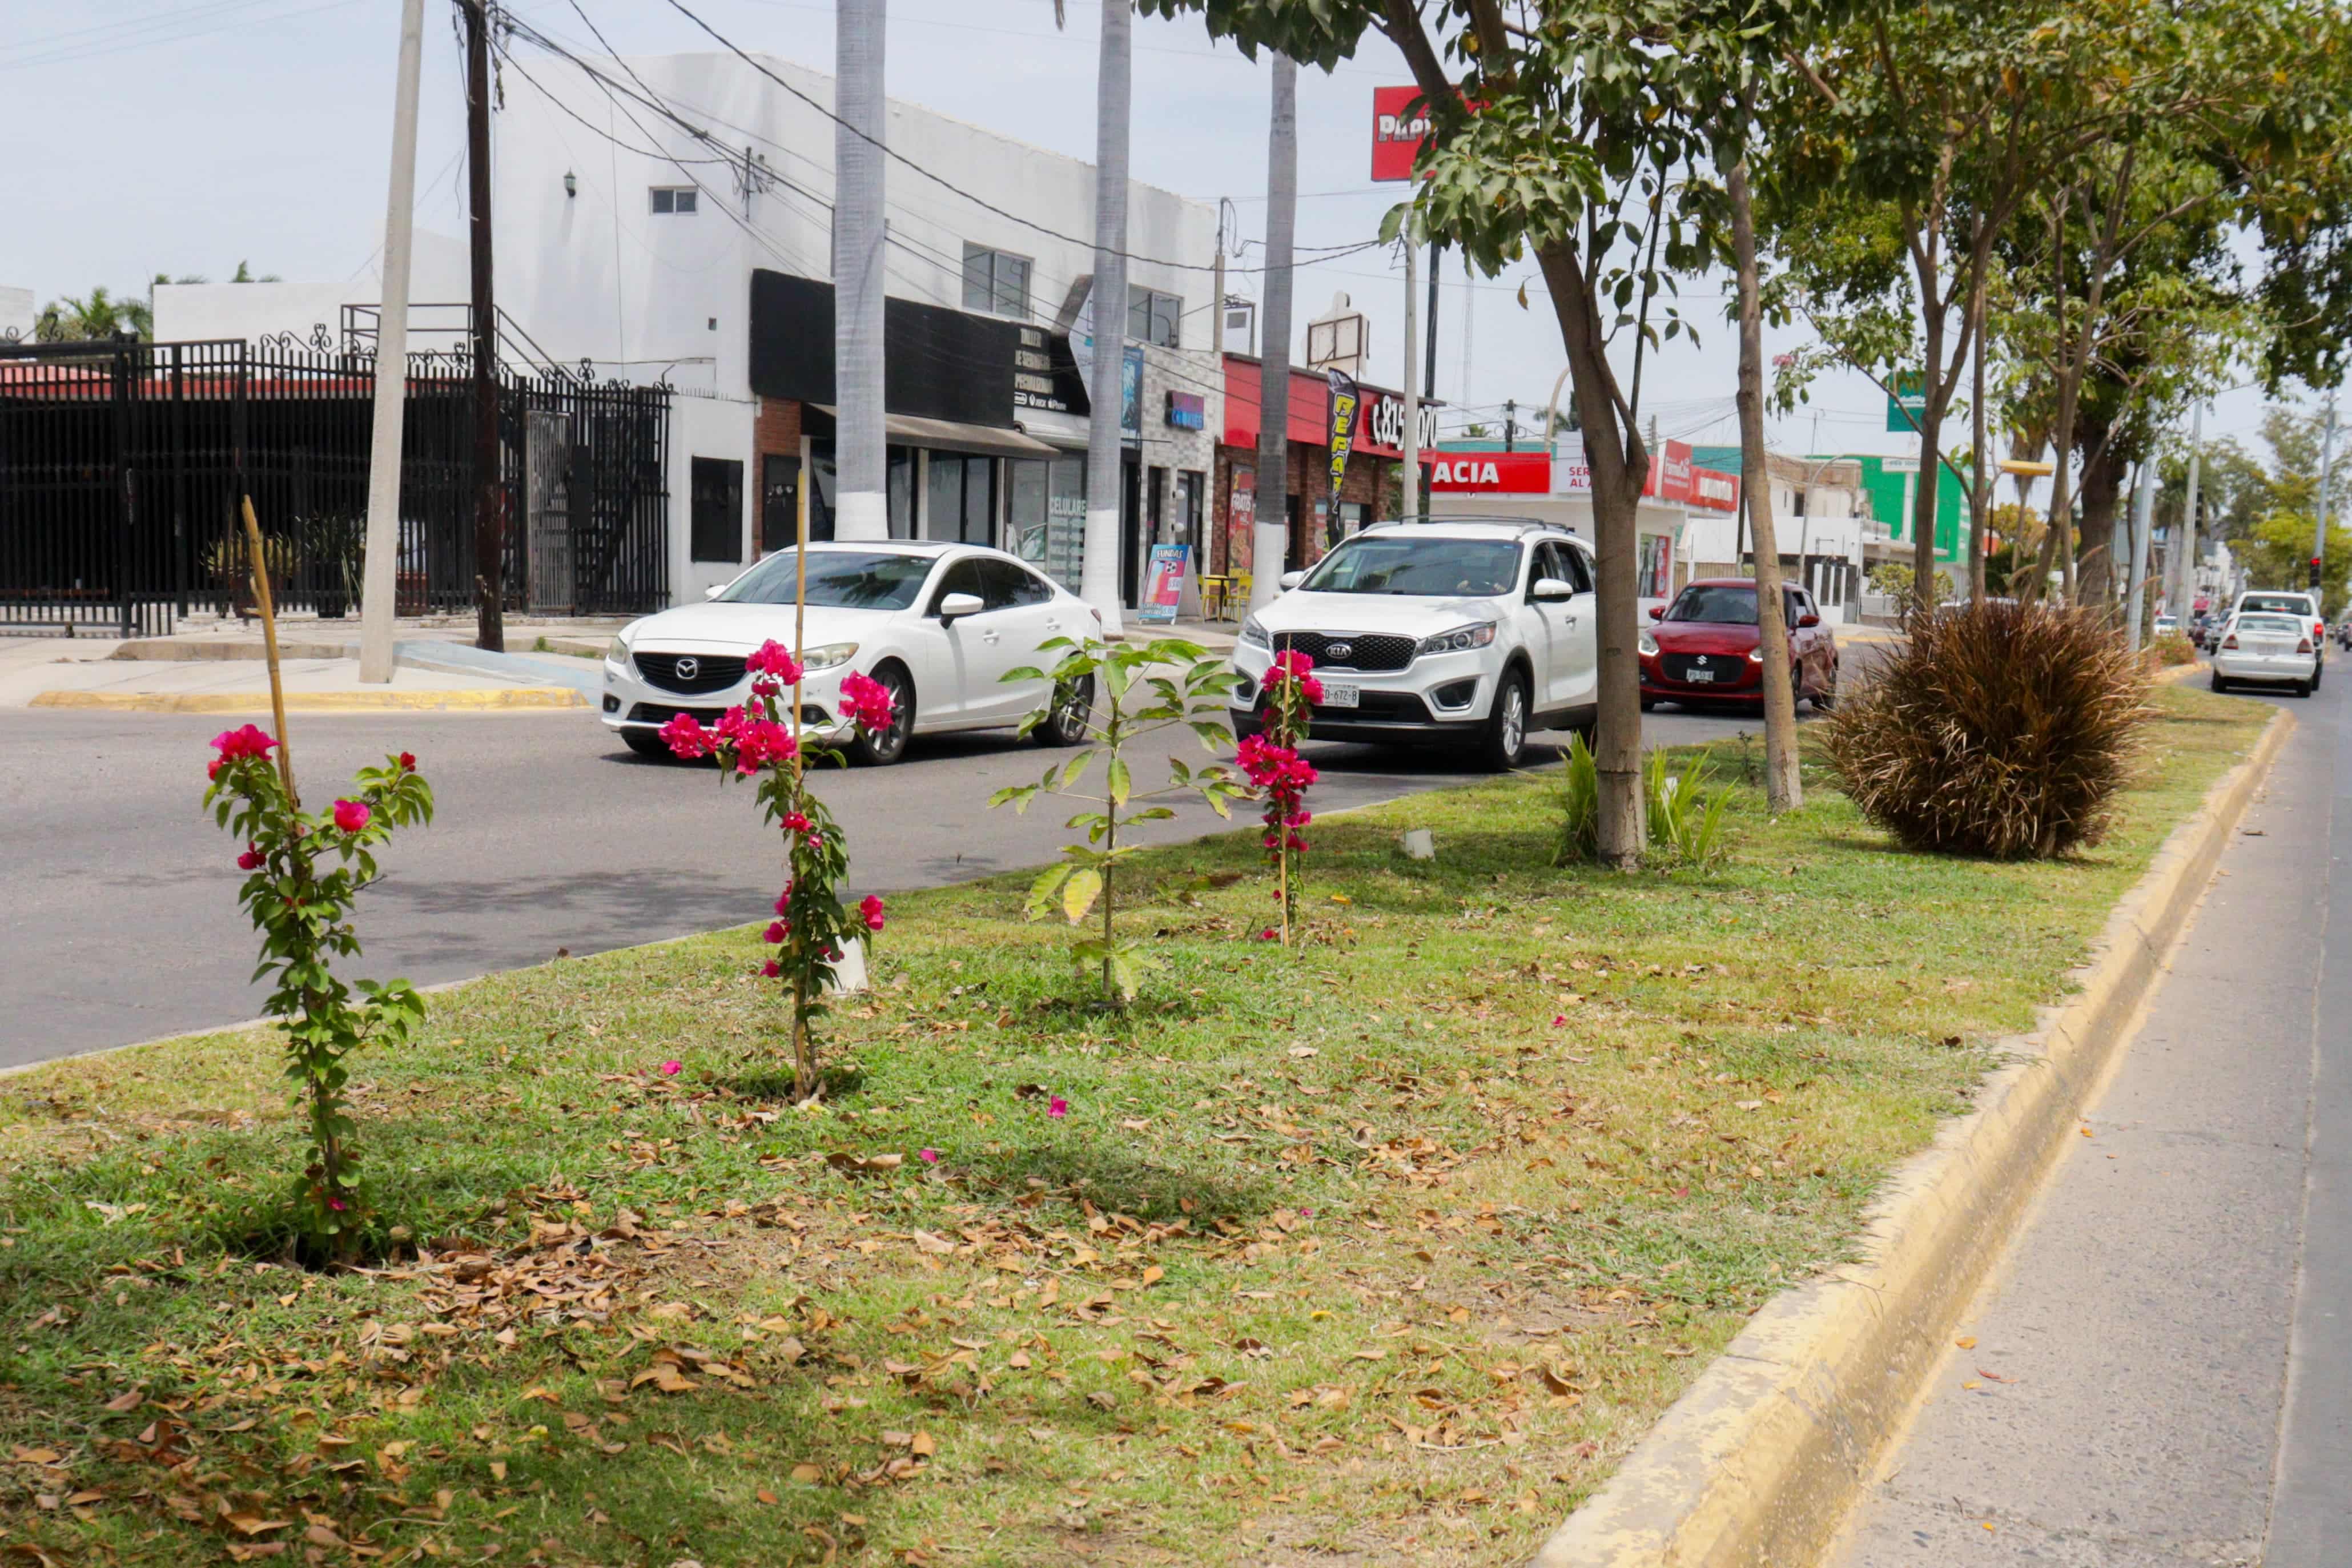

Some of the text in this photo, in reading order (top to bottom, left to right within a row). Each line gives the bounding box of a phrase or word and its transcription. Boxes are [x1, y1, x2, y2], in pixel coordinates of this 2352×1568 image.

[1430, 461, 1499, 484] ACIA
[1050, 496, 1086, 516] CELULARE
[1156, 549, 1184, 558] FUNDAS
[1329, 646, 1348, 656] KIA
